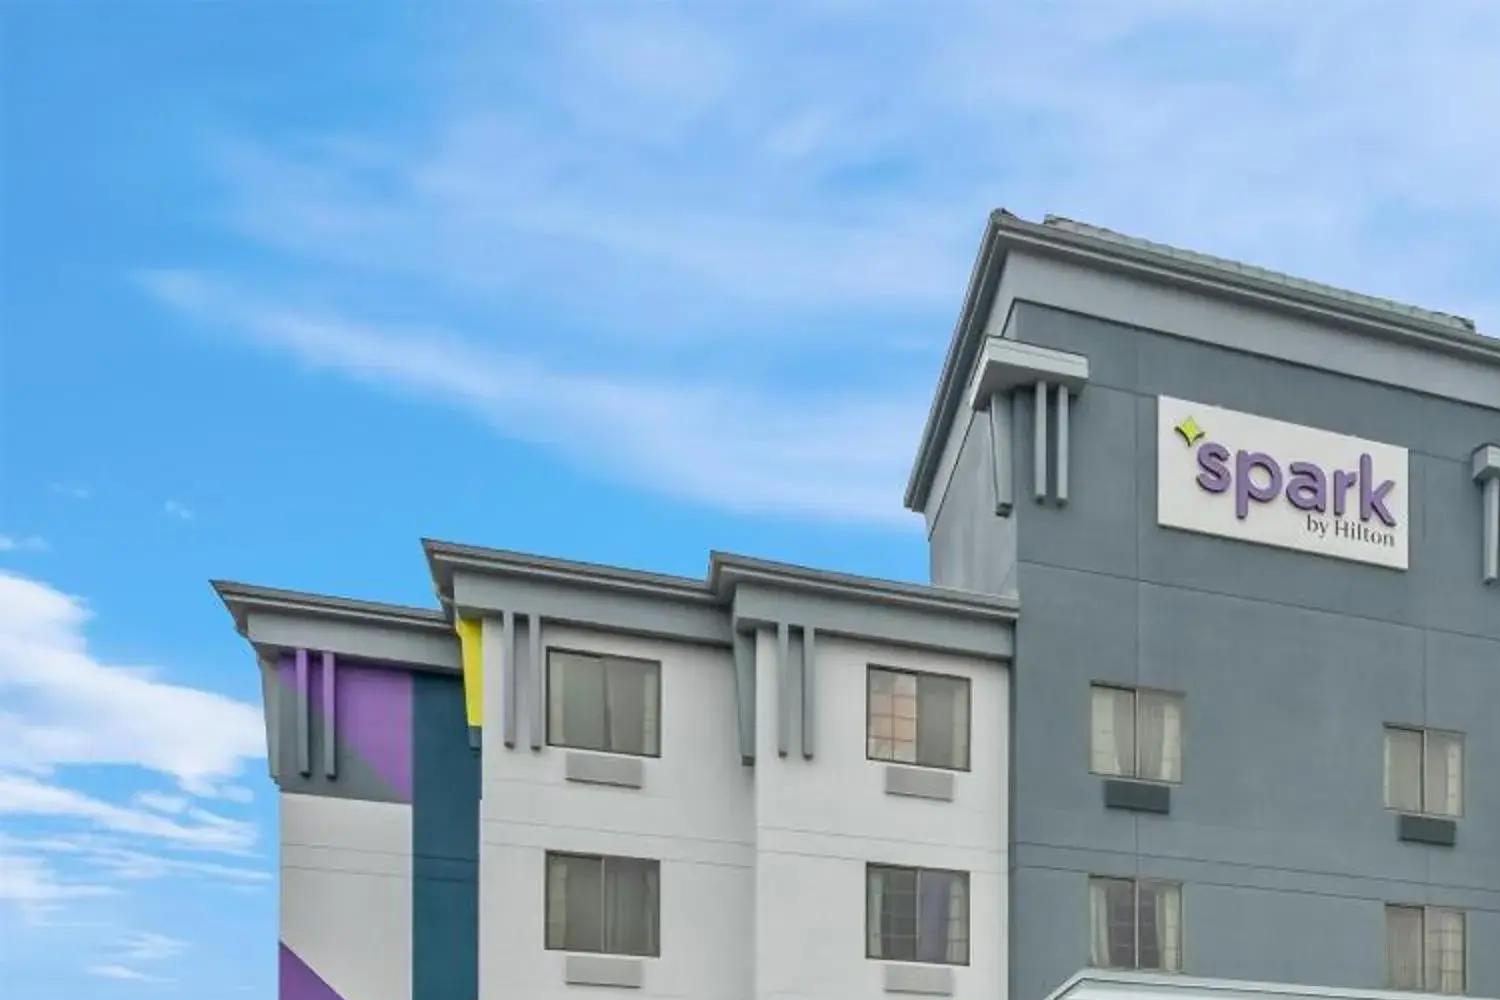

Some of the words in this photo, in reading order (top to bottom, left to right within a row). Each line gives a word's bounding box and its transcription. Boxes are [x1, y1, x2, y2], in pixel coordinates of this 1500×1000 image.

[1196, 442, 1396, 526] spark
[1306, 514, 1328, 538] by
[1334, 519, 1395, 547] Hilton
